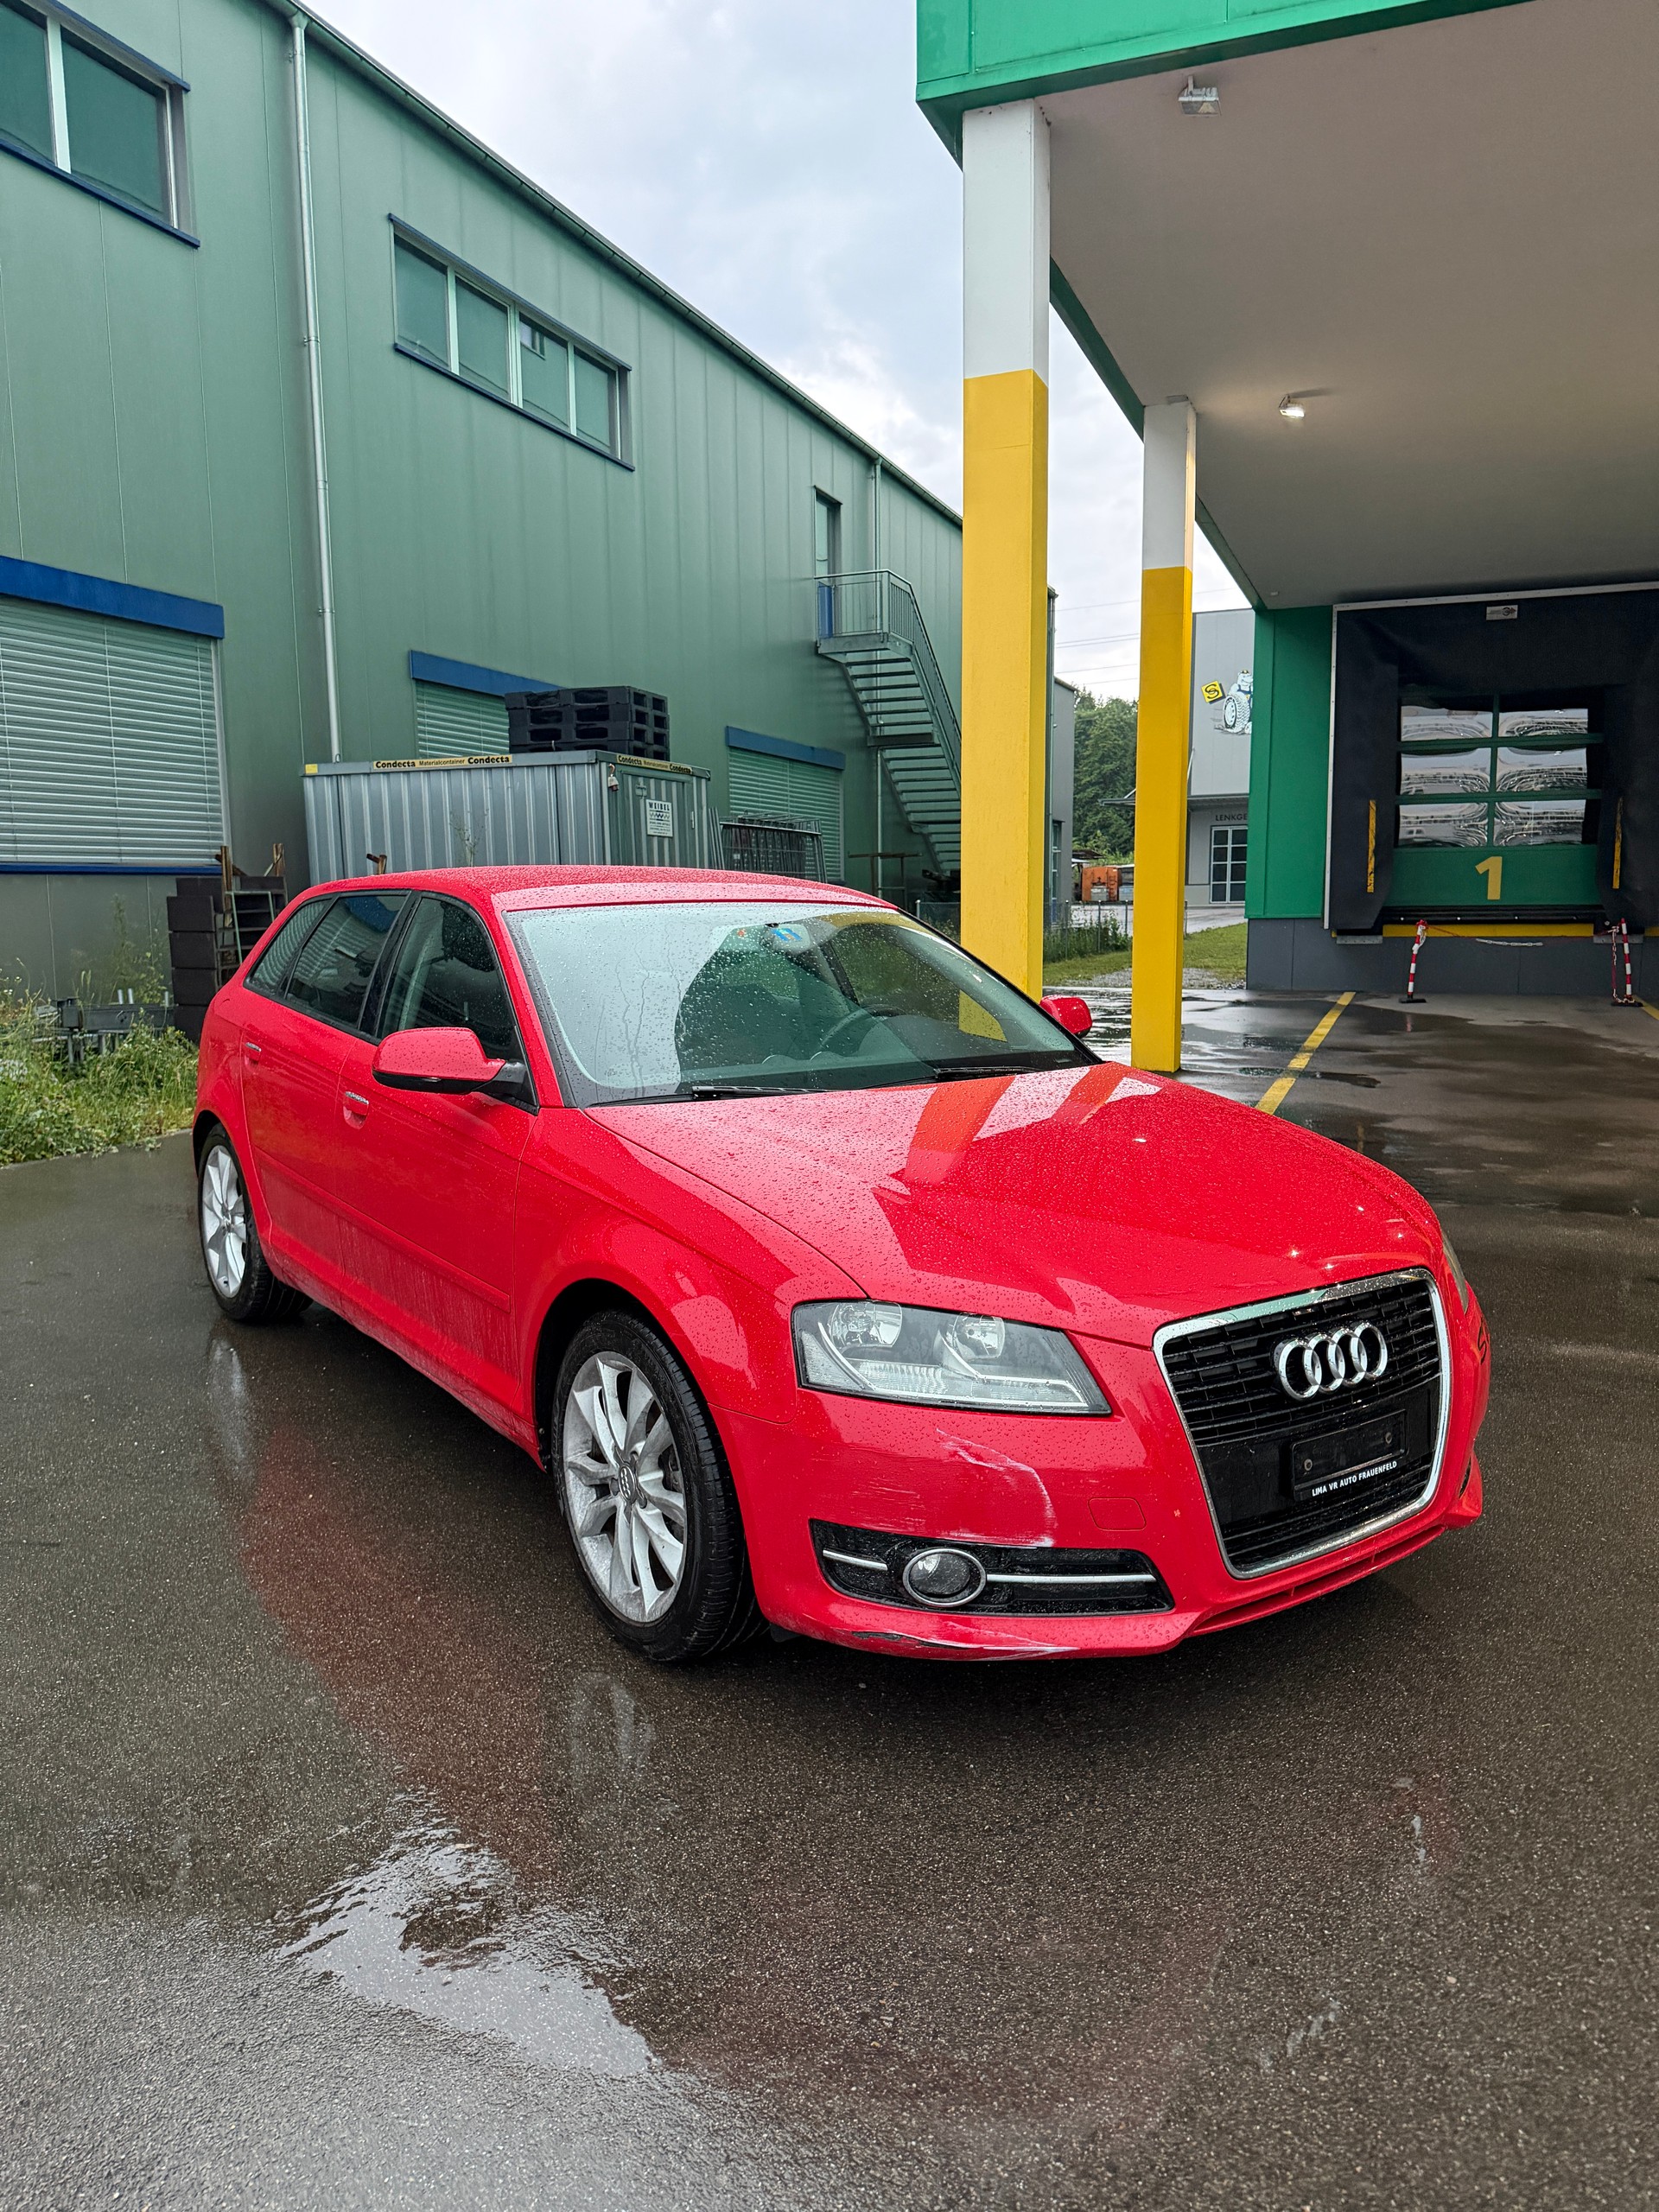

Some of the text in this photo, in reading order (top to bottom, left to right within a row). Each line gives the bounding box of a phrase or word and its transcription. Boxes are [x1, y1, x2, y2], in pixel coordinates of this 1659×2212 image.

[467, 755, 510, 765] Condecta
[618, 755, 642, 766] Condecta
[669, 764, 691, 773] Condecta
[1475, 855, 1503, 900] 1
[1312, 1460, 1397, 1497] LIMA VR AUTO FRAUENFELD
